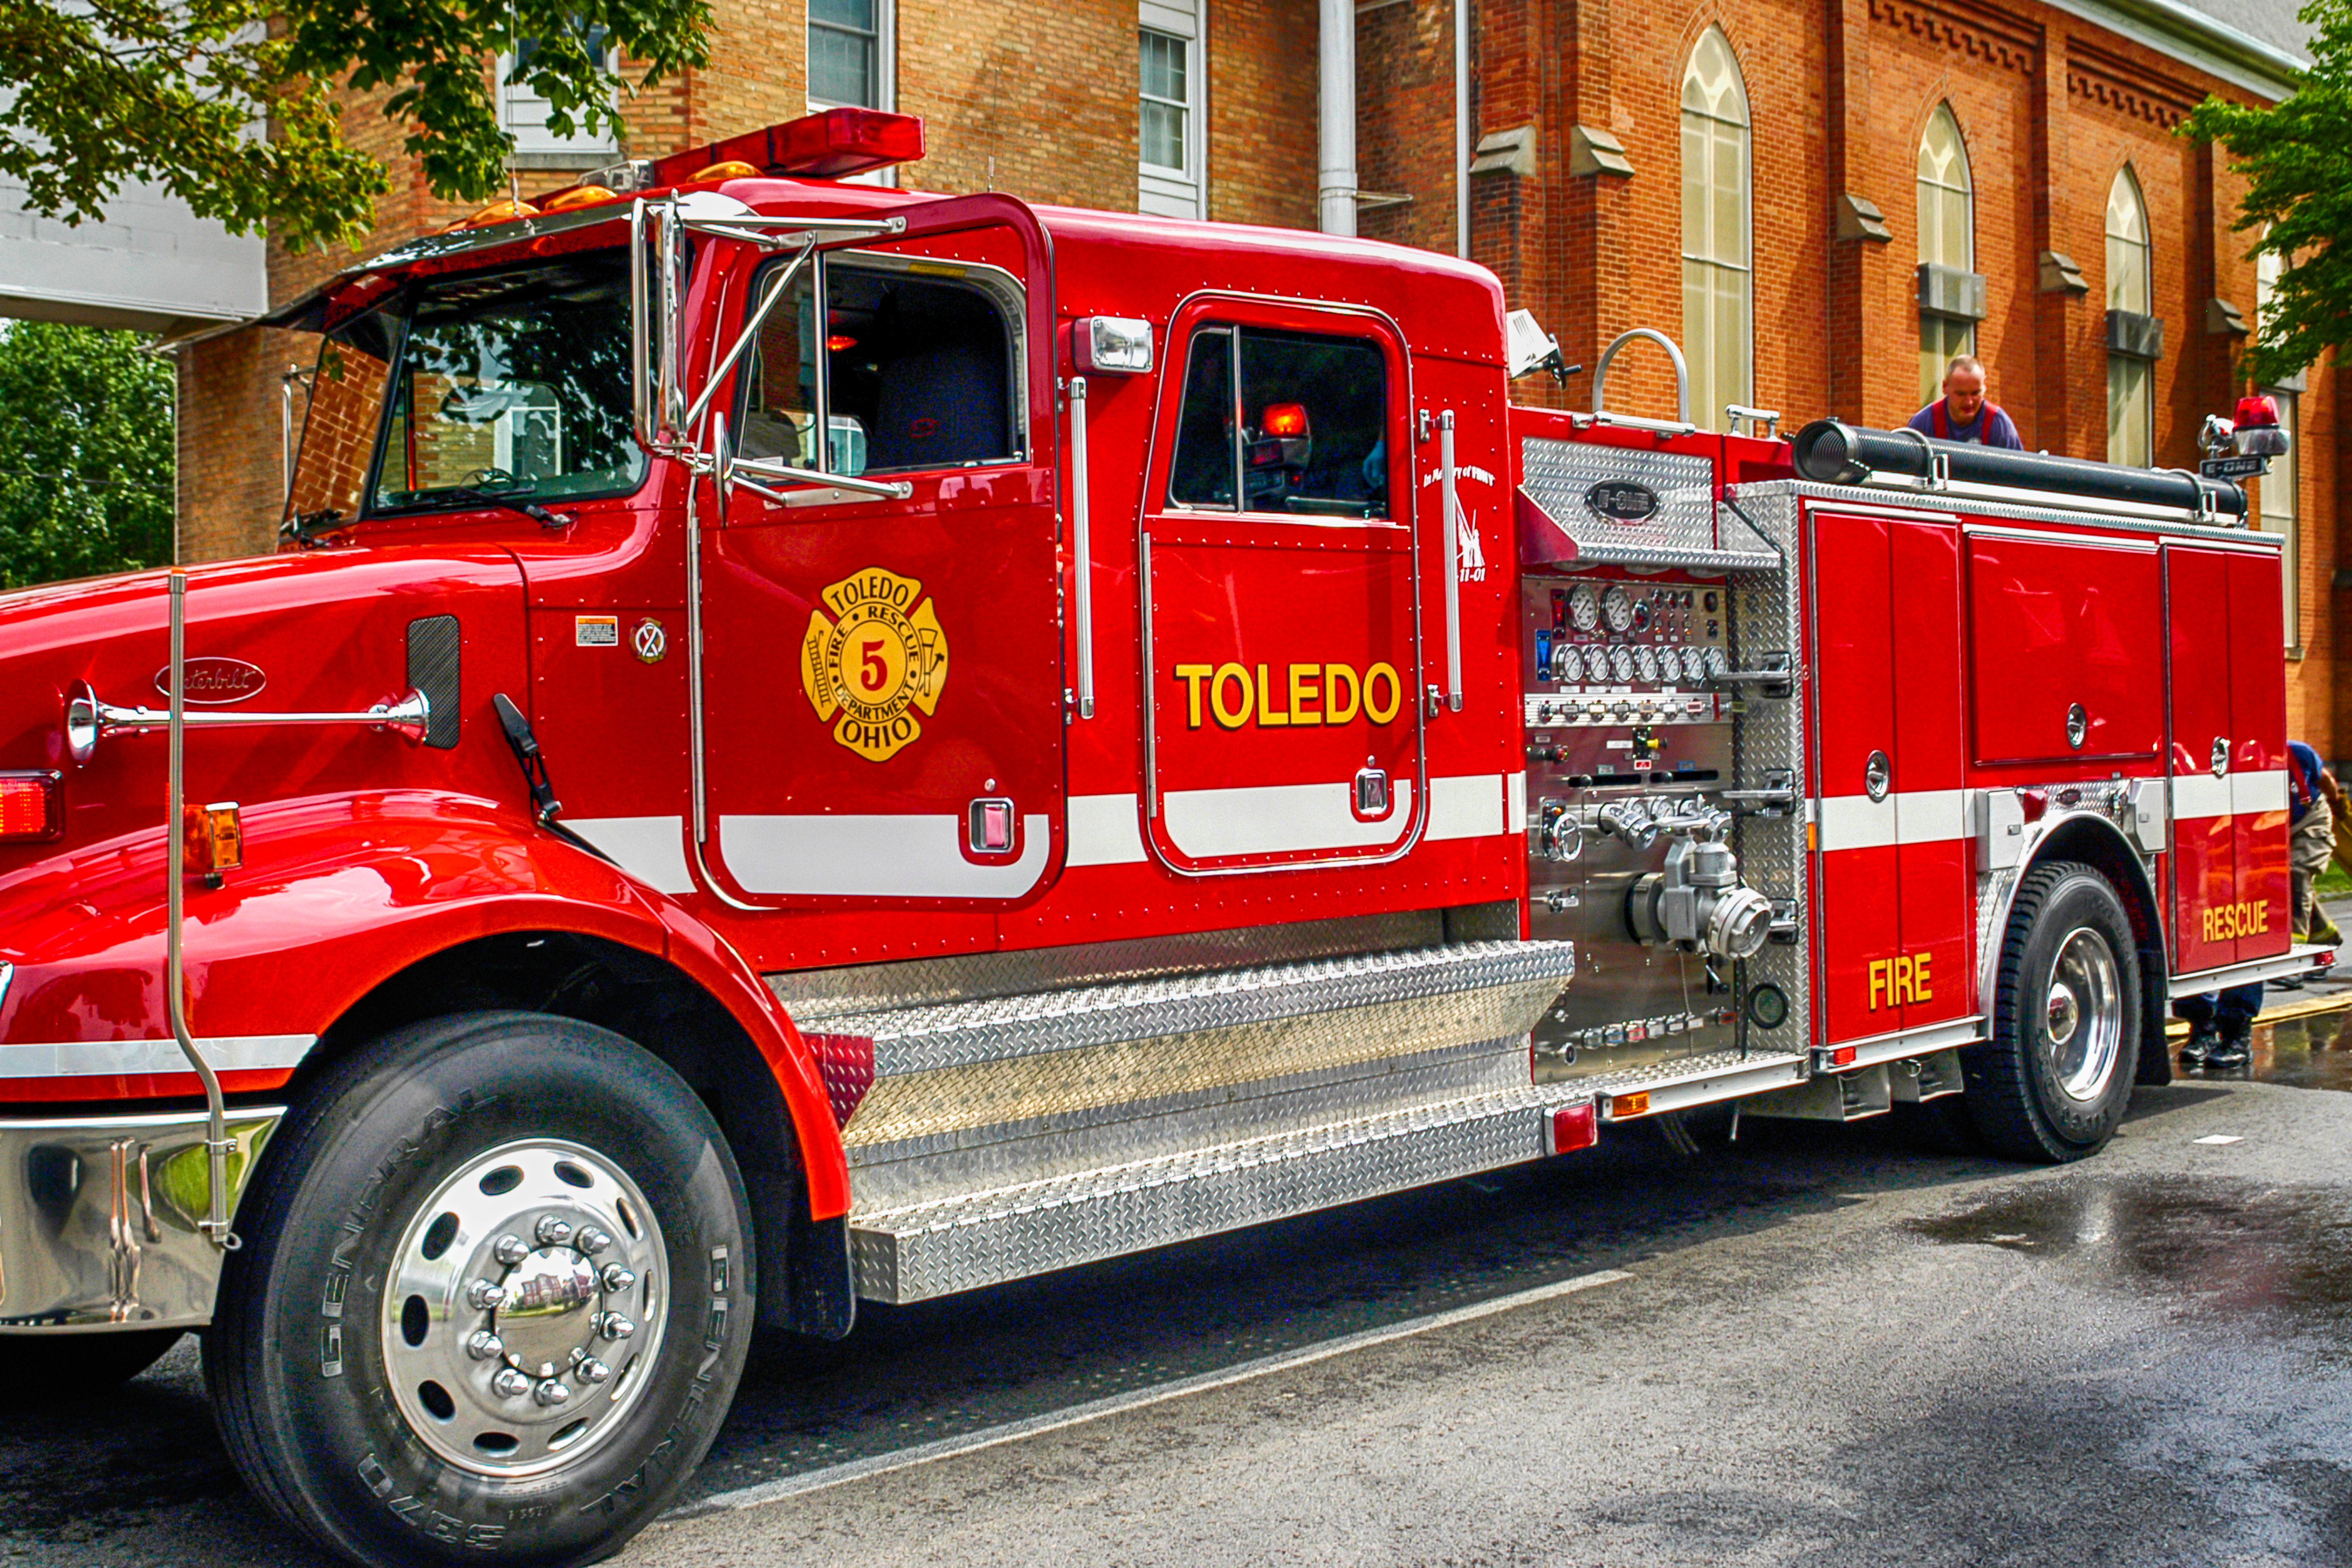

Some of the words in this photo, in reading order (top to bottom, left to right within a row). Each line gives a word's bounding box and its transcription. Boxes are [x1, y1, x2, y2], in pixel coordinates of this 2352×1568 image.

[1423, 474, 1432, 488] In
[1432, 466, 1462, 482] Mery
[831, 576, 909, 612] TOLEDO
[1458, 568, 1486, 582] 11-01
[828, 625, 849, 668] FIRE
[868, 606, 919, 662] RESCUE
[183, 668, 256, 689] eterbilt
[861, 639, 888, 691] 5
[834, 682, 915, 720] DEPARTMENT
[1175, 662, 1401, 729] TOLEDO
[842, 716, 912, 748] OHIO
[2203, 899, 2268, 944] RESCUE
[1869, 952, 1932, 1011] FIRE
[321, 1088, 497, 1378] GENERAL
[580, 1244, 729, 1513] GENERAL
